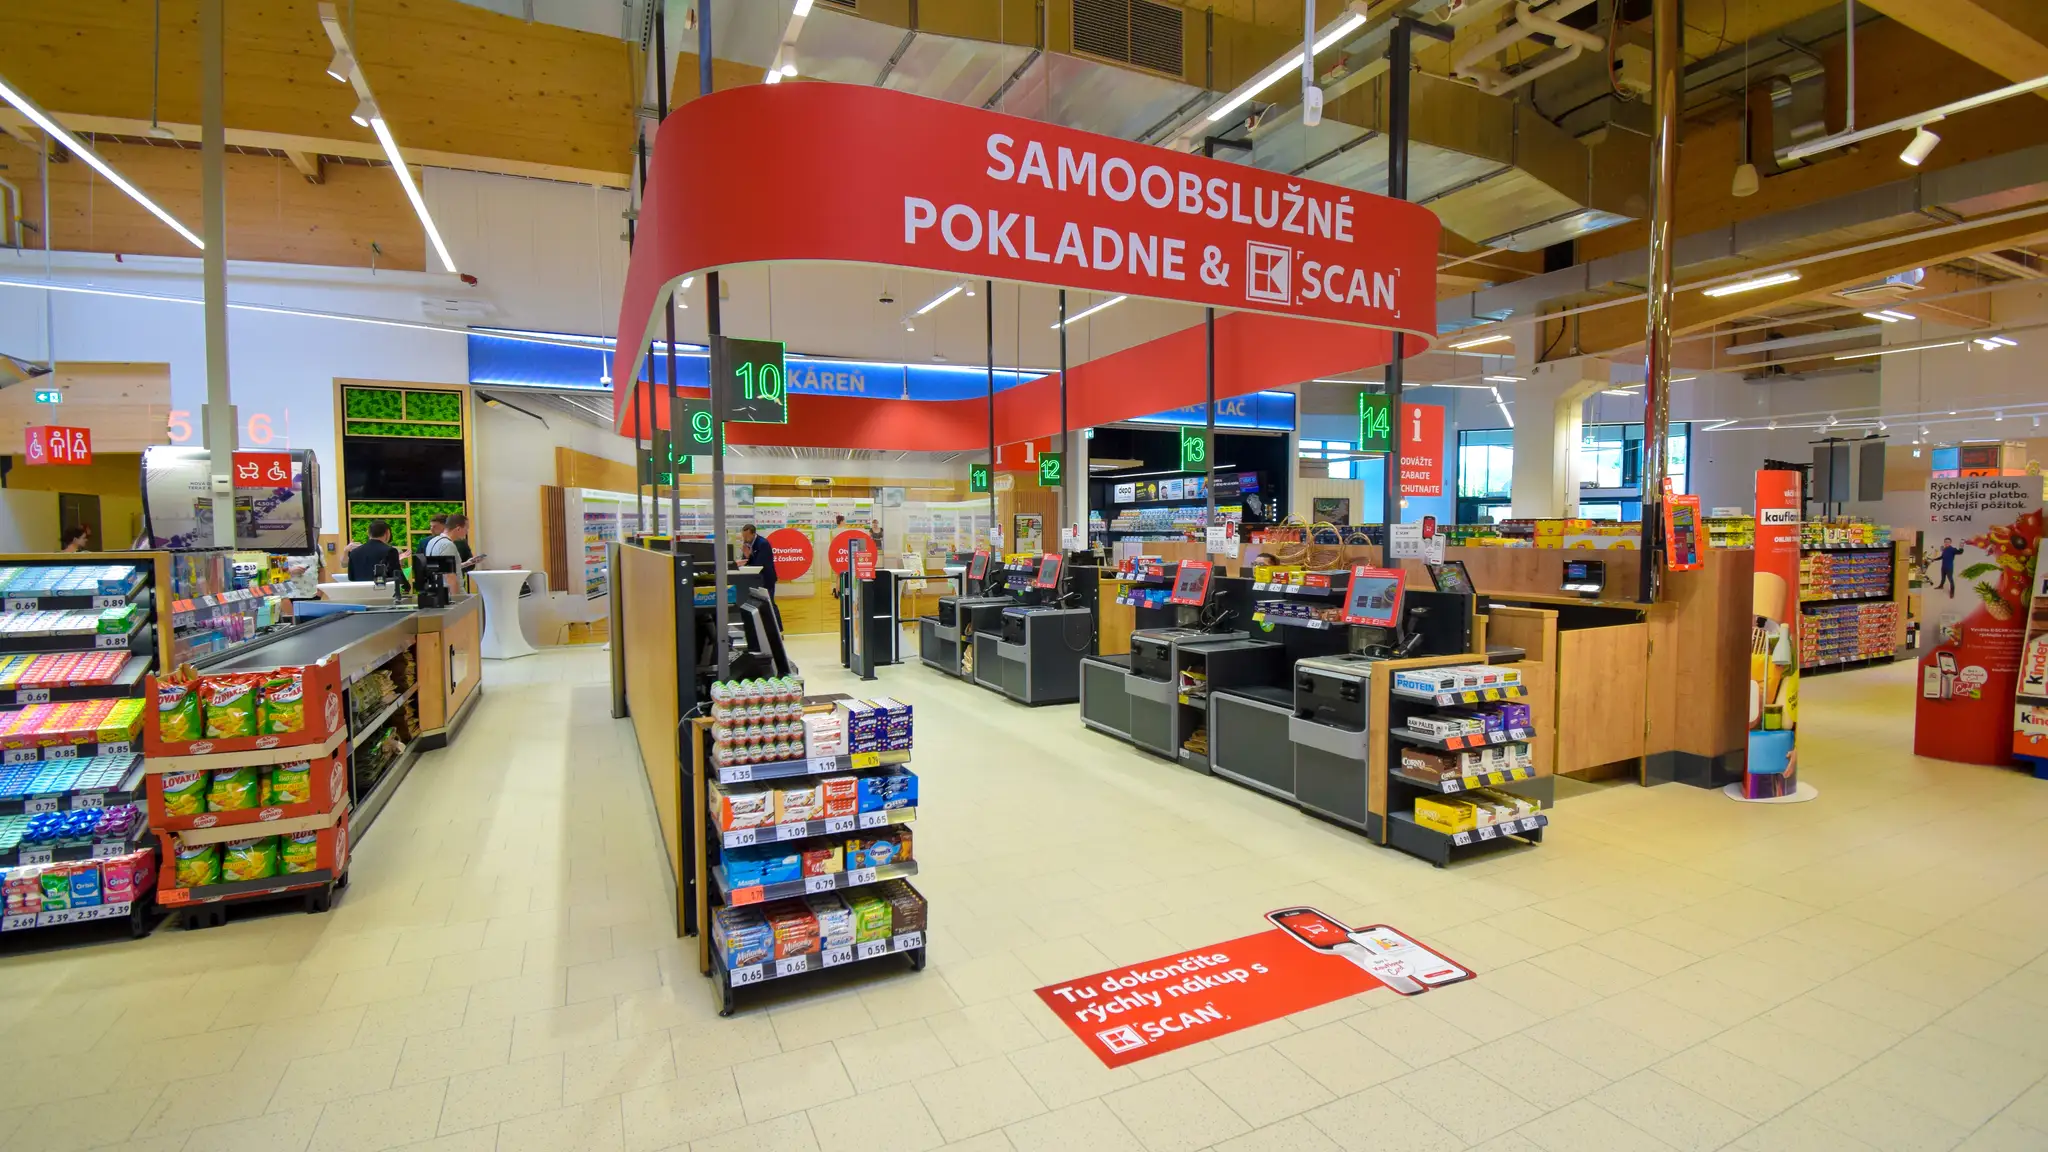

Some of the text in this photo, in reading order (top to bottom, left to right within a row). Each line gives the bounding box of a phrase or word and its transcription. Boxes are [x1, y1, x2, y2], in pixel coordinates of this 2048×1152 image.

[985, 132, 1354, 243] SAMOOBSLUŽNÉ
[903, 196, 1186, 281] POKLADNE
[1199, 245, 1230, 288] &
[1301, 260, 1395, 311] SCAN
[735, 361, 782, 401] 10
[167, 410, 192, 442] 5
[691, 411, 713, 443] 9
[1363, 406, 1390, 439] 14
[248, 413, 273, 444] 6
[1183, 437, 1205, 462] 13
[1040, 459, 1060, 479] 12
[973, 470, 987, 486] 11
[15, 602, 37, 610] 0.69
[103, 599, 124, 607] 0.89
[105, 638, 127, 646] 0.89
[1396, 679, 1435, 692] PROTEIN
[27, 692, 48, 701] 0.69
[55, 749, 76, 758] 0.85
[108, 745, 129, 754] 0.85
[15, 752, 36, 761] 0.85
[819, 761, 836, 771] 1.19
[732, 770, 751, 780] 1.35
[35, 802, 56, 811] 0.75
[82, 798, 102, 807] 0.75
[835, 820, 854, 830] 0.49
[868, 815, 887, 825] 0.65
[788, 827, 806, 837] 1.09
[735, 834, 755, 844] 1.09
[103, 847, 123, 856] 2.89
[30, 854, 51, 864] 2.89
[858, 872, 876, 883] 0.55
[815, 879, 834, 890] 0.79
[77, 910, 98, 920] 2.39
[108, 905, 129, 915] 2.39
[13, 918, 34, 928] 2.69
[47, 913, 69, 923] 2.39
[903, 937, 921, 948] 0.75
[867, 944, 886, 956] 0.59
[832, 951, 851, 963] 0.46
[786, 960, 806, 972] 0.65
[741, 970, 762, 982] 0.65
[1053, 952, 1231, 1004] Tu dokončite
[1075, 962, 1269, 1024] rýchly nákup s
[1141, 1003, 1224, 1038] SCAN
